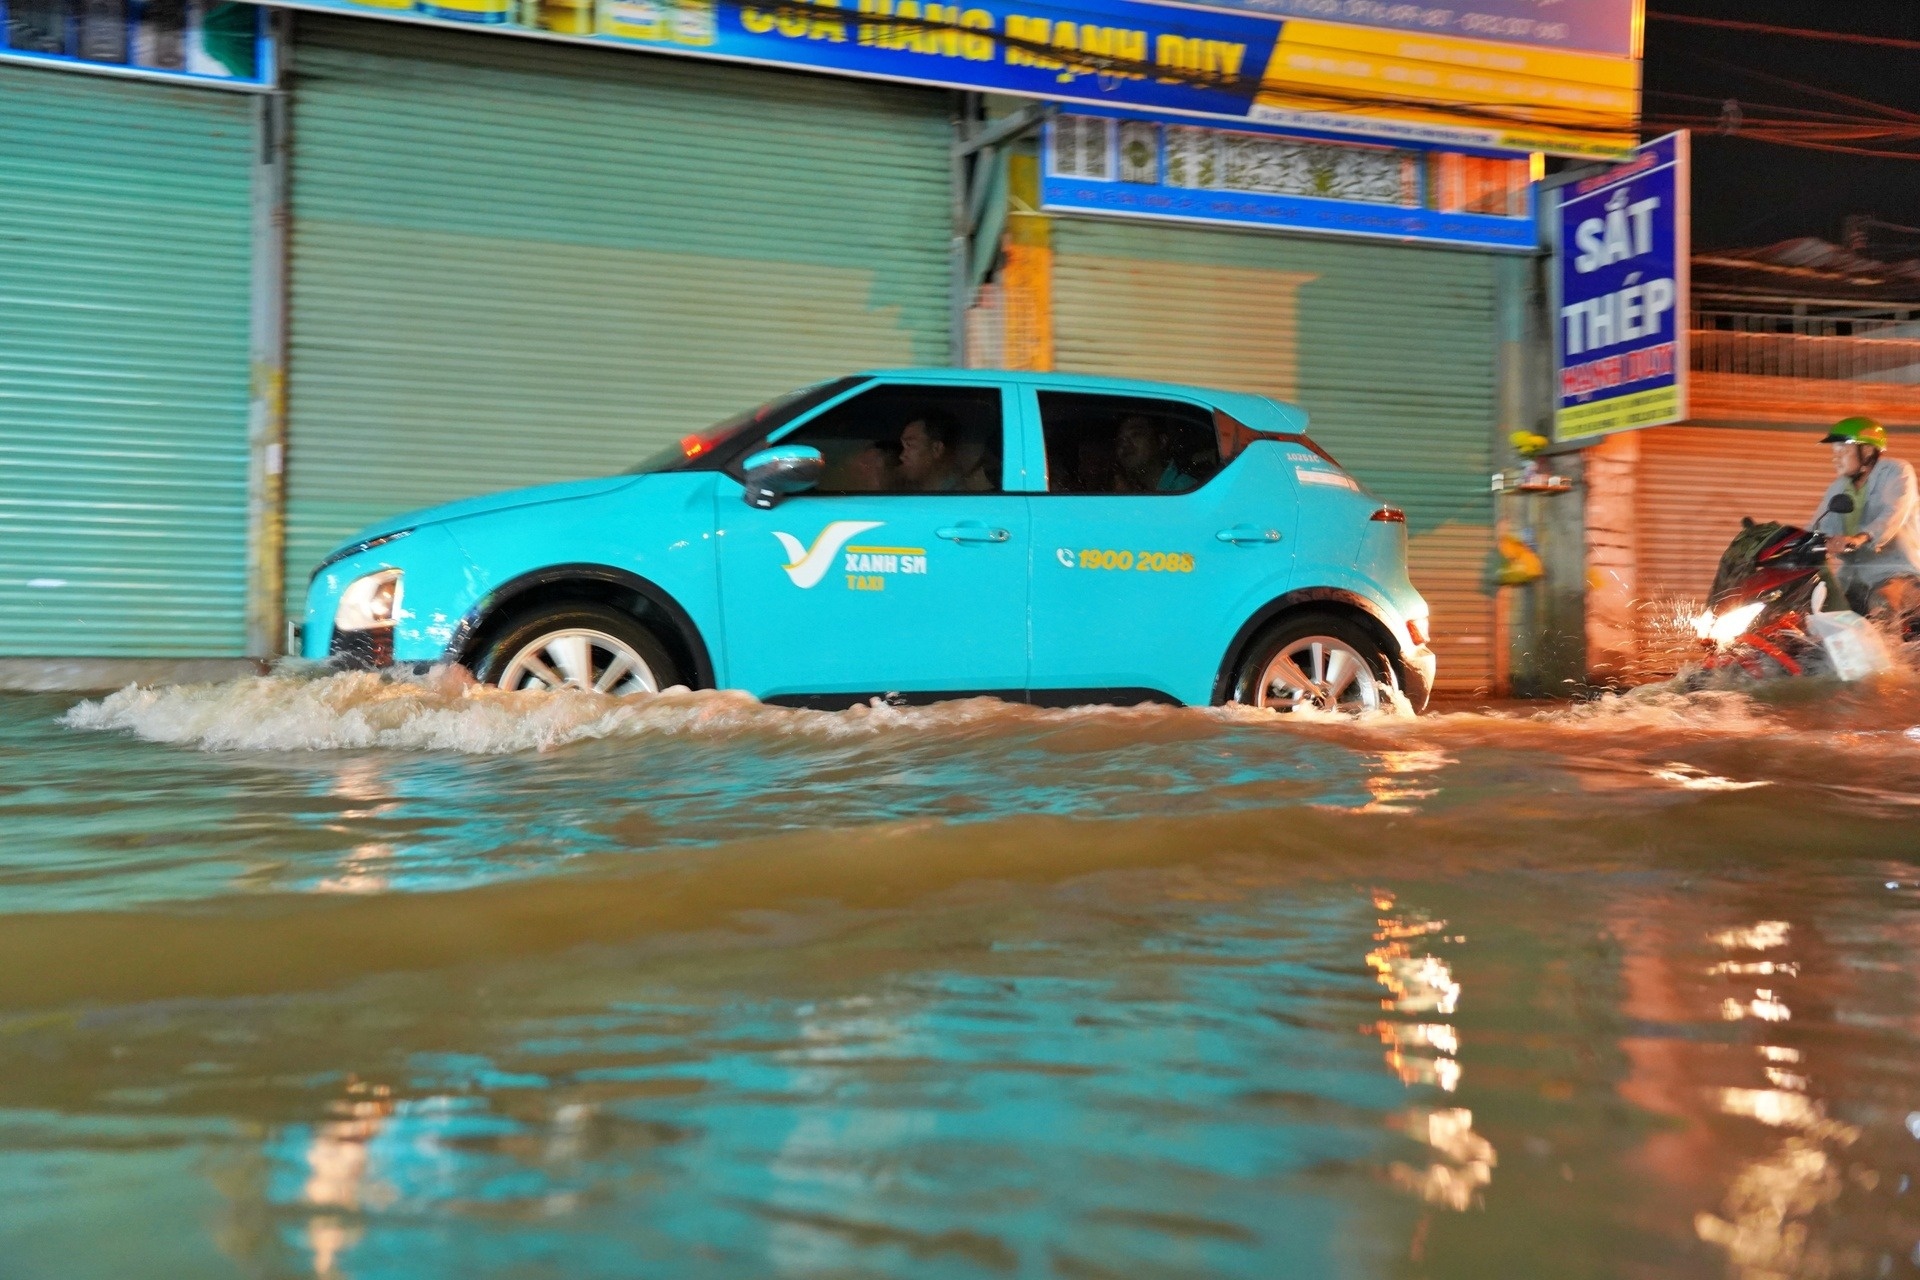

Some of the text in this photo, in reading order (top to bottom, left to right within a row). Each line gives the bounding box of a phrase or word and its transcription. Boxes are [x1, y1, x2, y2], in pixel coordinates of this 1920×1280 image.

[1574, 187, 1660, 274] SẮT
[1560, 271, 1675, 355] THÉP
[845, 554, 927, 574] XANH SM
[1079, 549, 1194, 573] 1900 2088
[845, 575, 885, 591] TAXI
